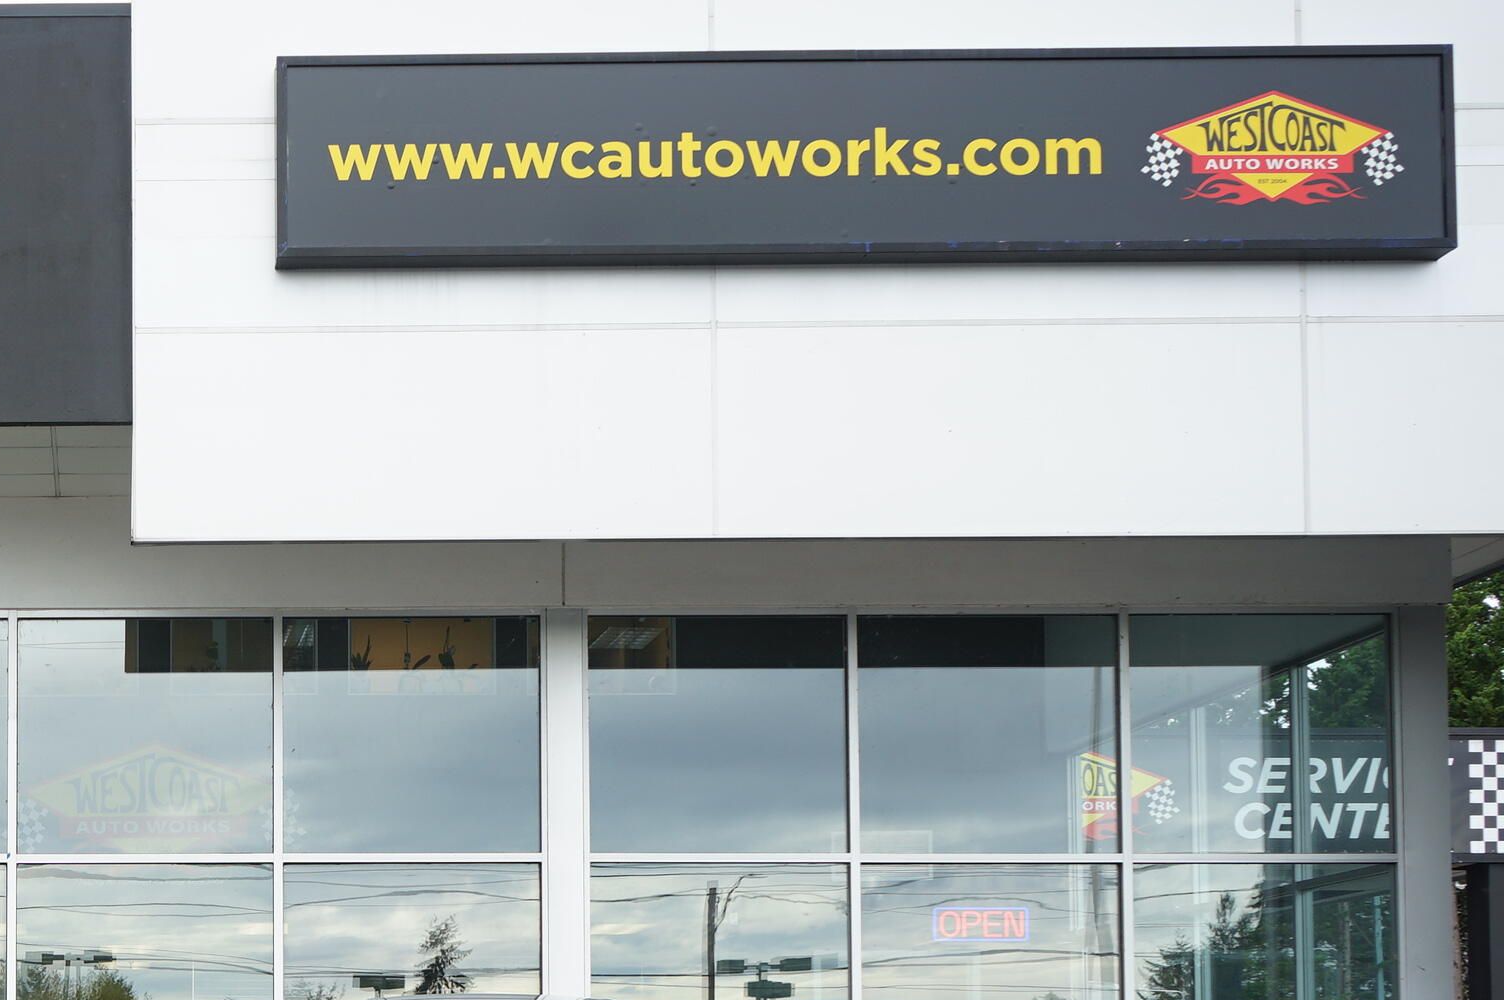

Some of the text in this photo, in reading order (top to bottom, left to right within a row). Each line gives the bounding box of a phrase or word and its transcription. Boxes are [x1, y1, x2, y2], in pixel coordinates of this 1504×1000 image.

[328, 126, 1103, 182] www.wcautoworks.com
[1205, 157, 1339, 171] AUTO WORKS
[1222, 757, 1390, 794] SERVI
[75, 818, 232, 835] AUTO WORKS
[1234, 802, 1391, 840] CENTE
[938, 910, 1026, 938] OPEN
